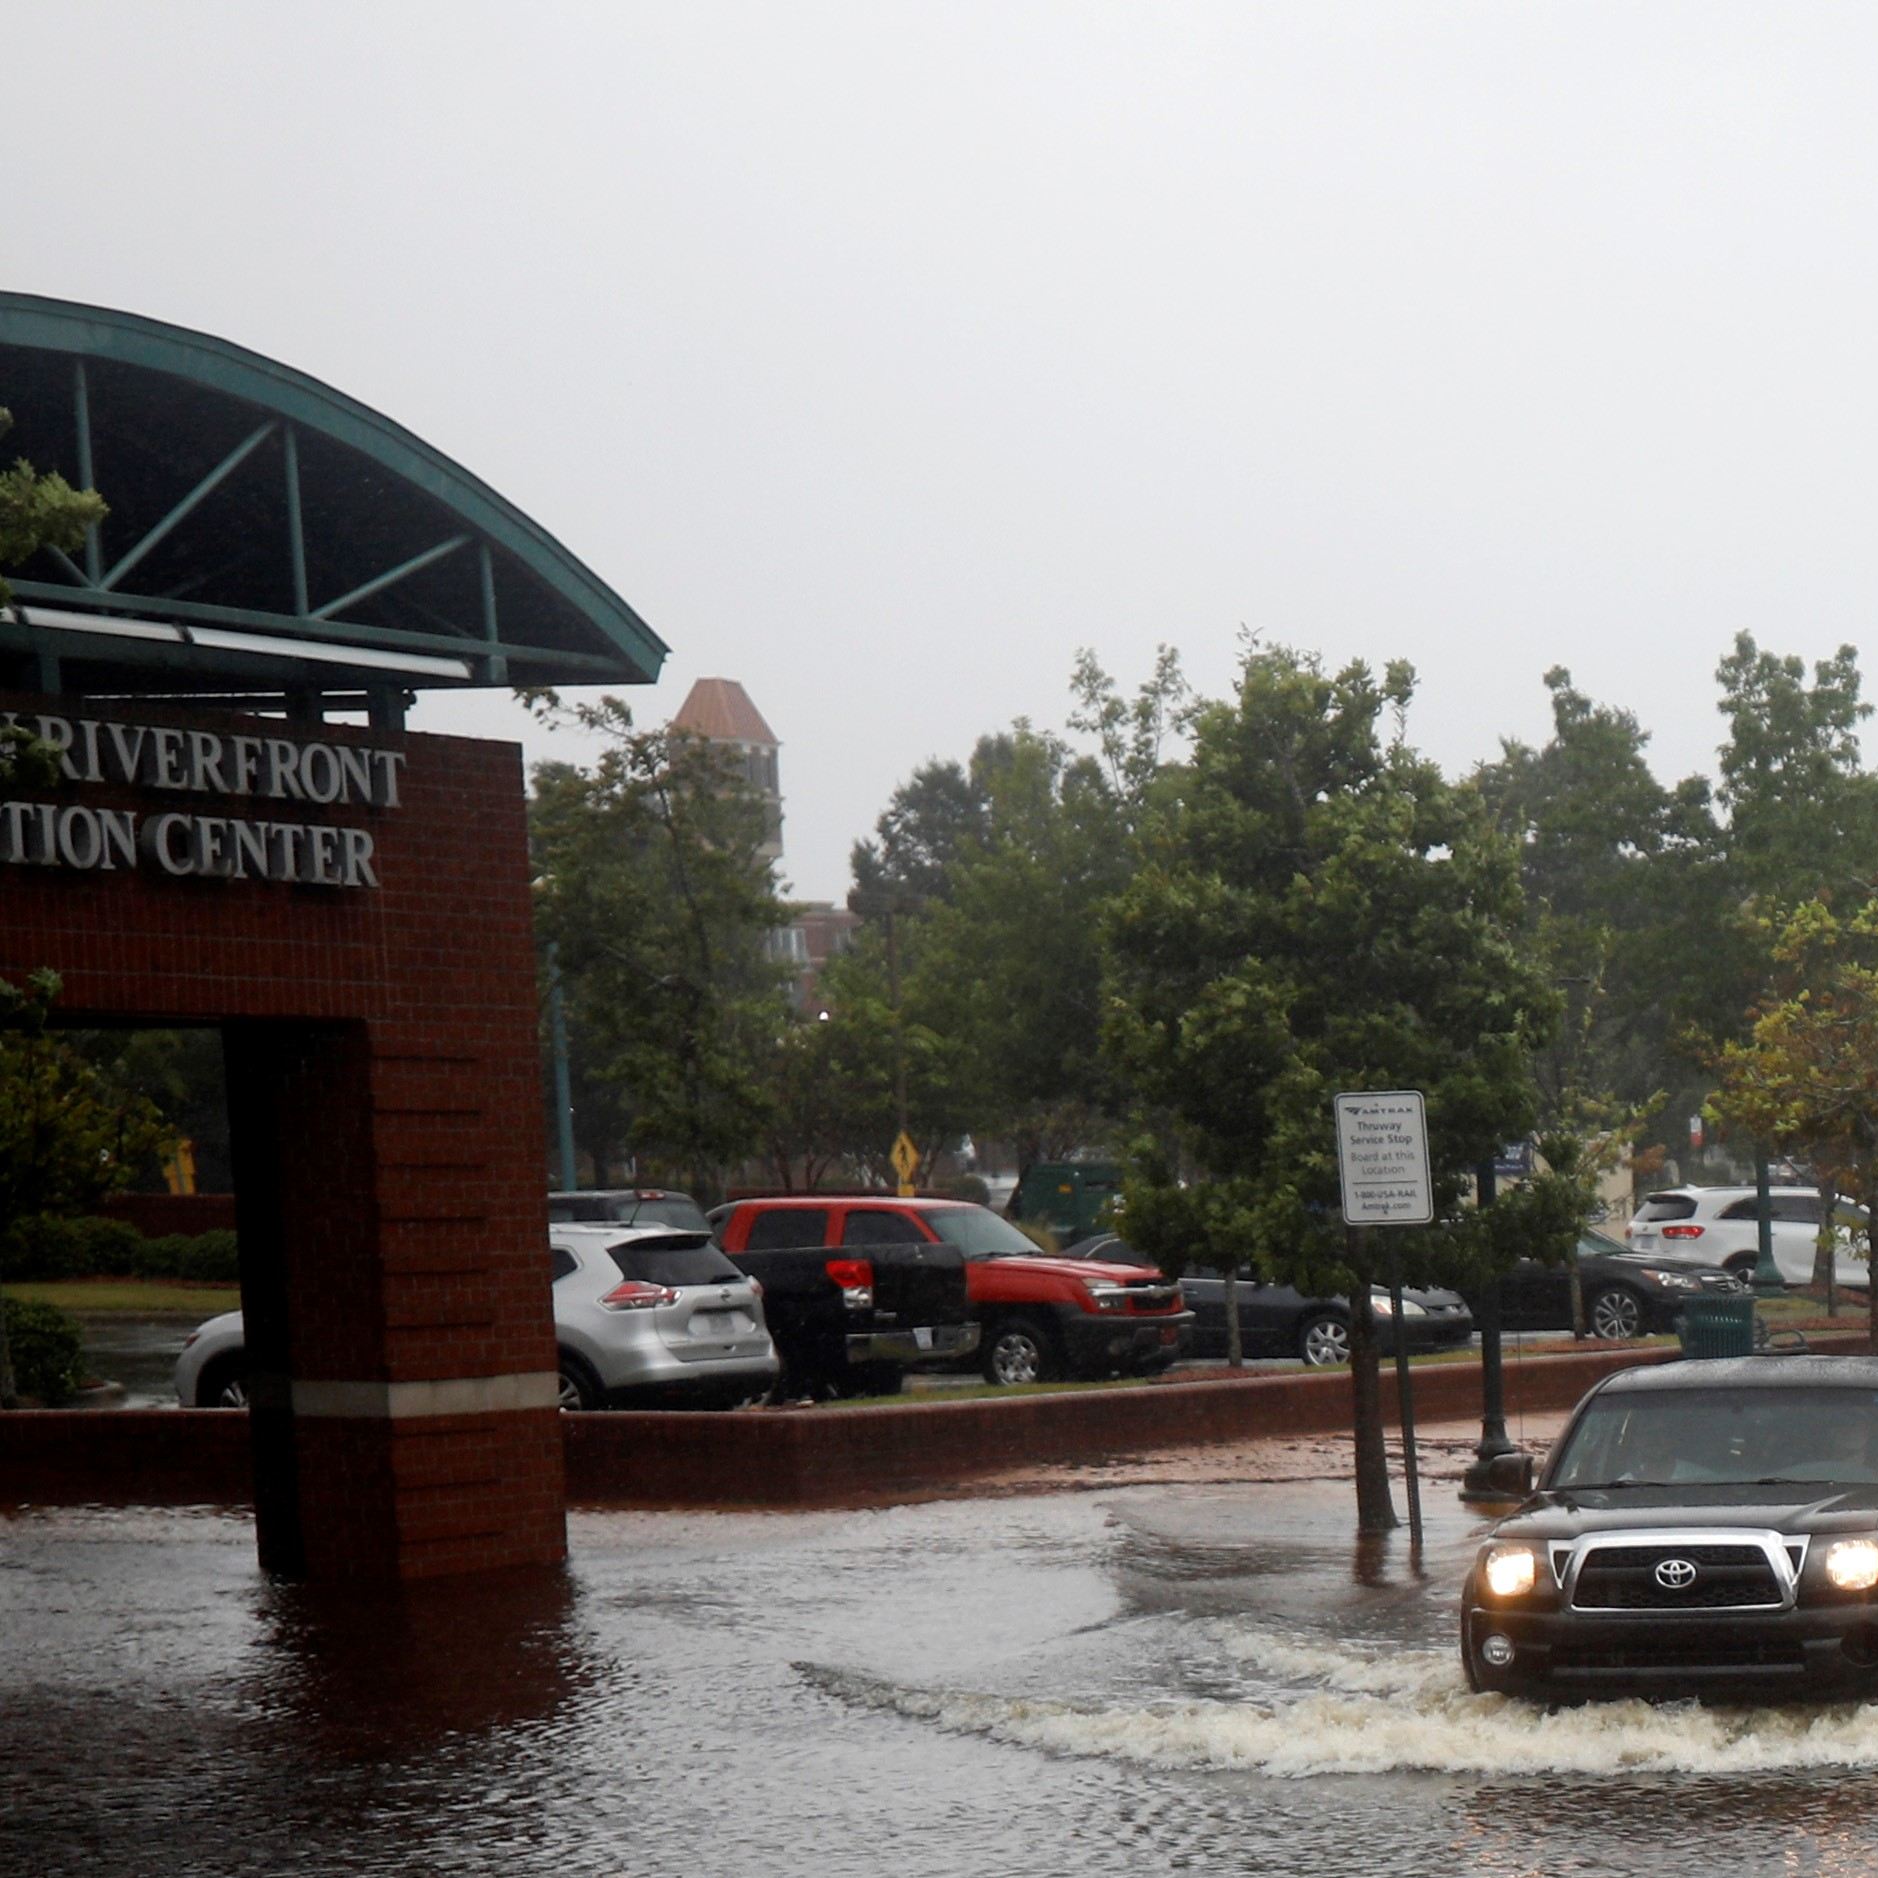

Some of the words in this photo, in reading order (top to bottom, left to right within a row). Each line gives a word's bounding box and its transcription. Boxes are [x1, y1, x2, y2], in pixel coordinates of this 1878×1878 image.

[35, 714, 406, 808] RIVERFRONT
[152, 812, 380, 889] CENTER
[1357, 1121, 1402, 1132] Thruway
[1350, 1135, 1384, 1145] Service
[1387, 1133, 1413, 1145] Stop
[1351, 1152, 1380, 1162] Board
[1382, 1152, 1392, 1161] at
[1395, 1150, 1416, 1160] this
[1361, 1165, 1406, 1175] Location
